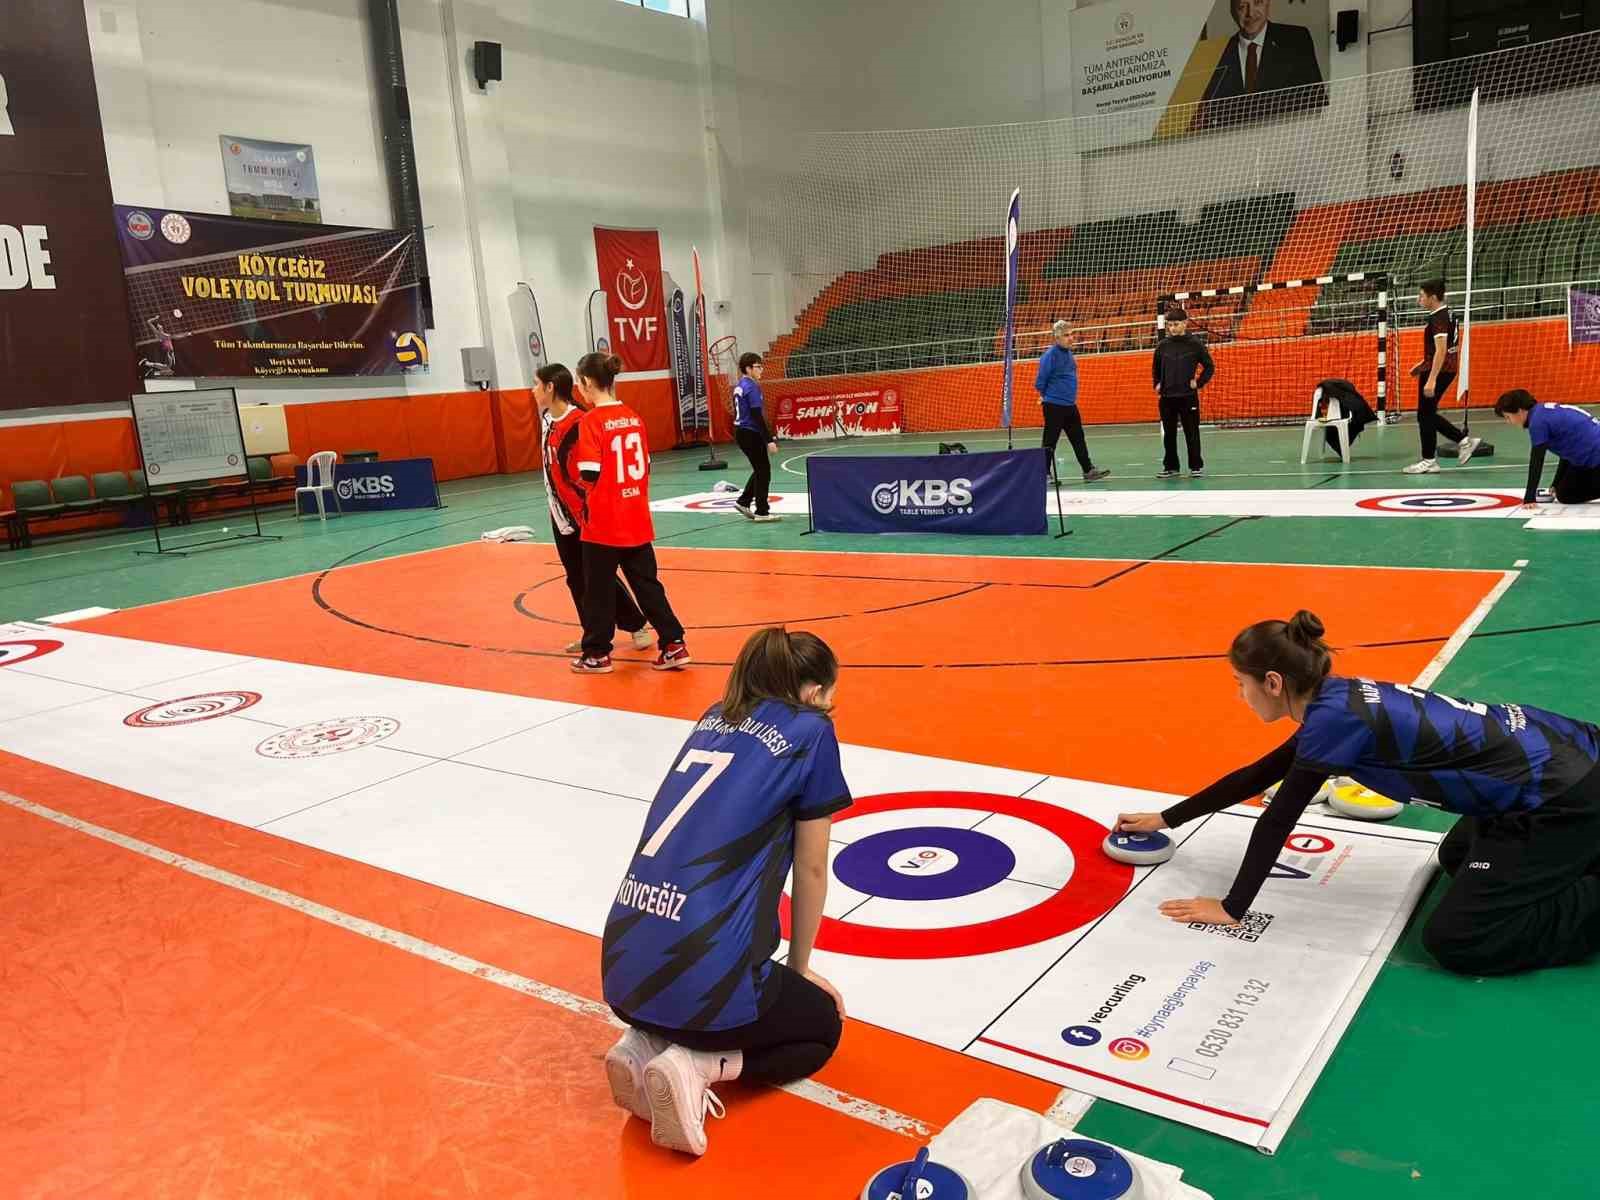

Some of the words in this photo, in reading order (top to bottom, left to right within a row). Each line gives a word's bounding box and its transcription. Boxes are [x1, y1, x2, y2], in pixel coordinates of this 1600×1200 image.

[1086, 58, 1167, 86] SPORCULARIMIZA
[1105, 48, 1156, 70] ANTRENÖR
[1156, 47, 1169, 58] VE
[1081, 79, 1125, 96] BAŞARILAR
[1125, 69, 1171, 86] DİLİYORUM
[238, 253, 326, 279] KÖYCEĞİZ
[180, 276, 281, 301] VOLEYBOL
[613, 316, 658, 342] TVF
[215, 339, 235, 349] Tüm
[611, 432, 646, 484] 13
[351, 474, 394, 495] KBS
[899, 477, 973, 507] KBS
[754, 724, 793, 757] LİSESİ
[640, 747, 736, 858] 7
[616, 873, 688, 922] KÖYCEĞİZ
[1087, 972, 1147, 1026] veocurling
[1135, 959, 1217, 1040] #oynaeğlenpaylaş
[1195, 1028, 1233, 1059] 0530
[1216, 1006, 1249, 1031] 831
[1233, 991, 1259, 1008] 13
[1247, 977, 1270, 996] 32
